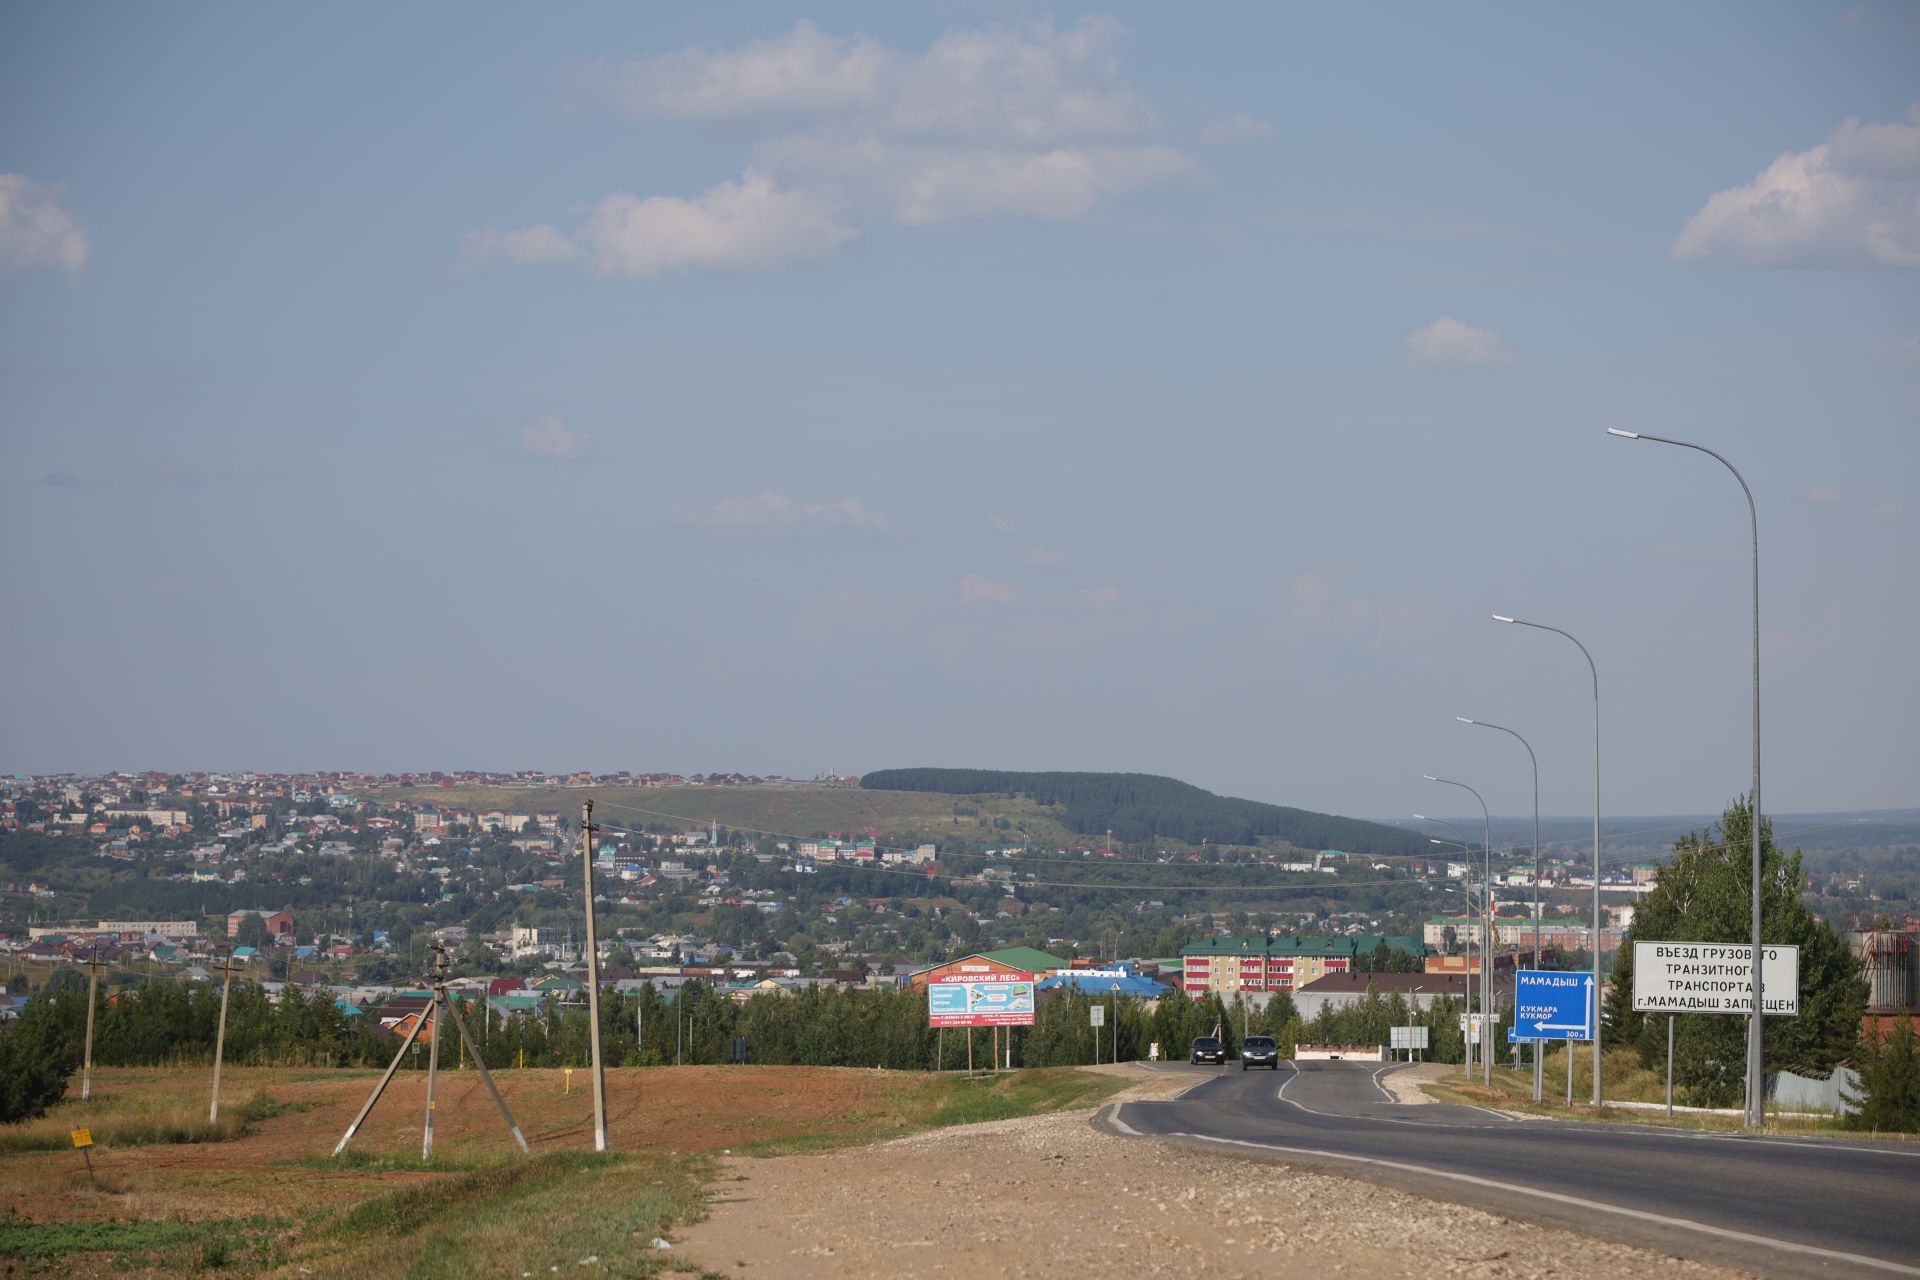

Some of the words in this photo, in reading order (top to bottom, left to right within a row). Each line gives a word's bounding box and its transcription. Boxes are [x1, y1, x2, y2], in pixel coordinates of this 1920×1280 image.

[1656, 947, 1699, 960] ВЪЕЗД
[1703, 948, 1777, 961] ГРУЗОВГО
[1666, 963, 1754, 976] ТРАНЗИТНОГ
[1520, 976, 1578, 987] МАМАДЫШ
[1668, 980, 1753, 993] ТРАНСПОРТА
[1520, 1005, 1558, 1014] КУКМАРА
[1566, 1030, 1579, 1038] 300
